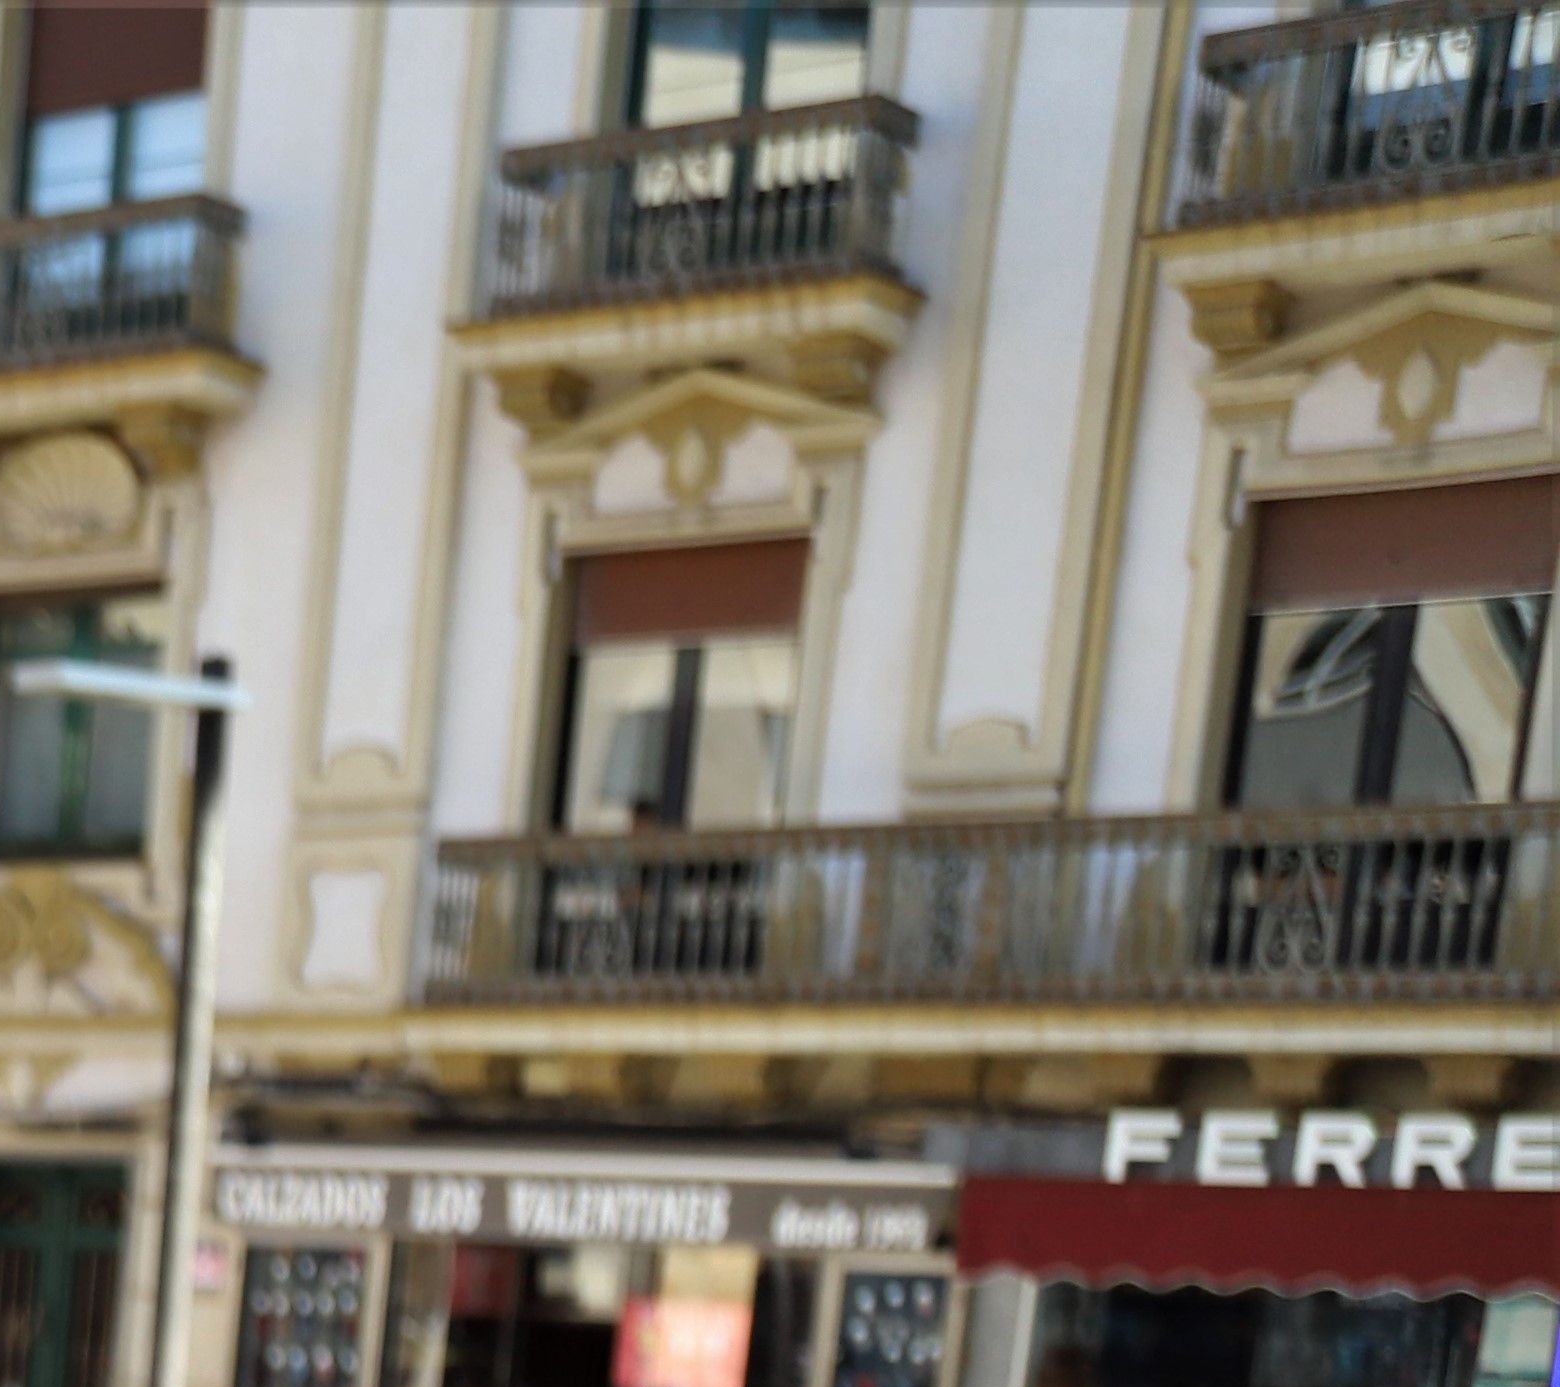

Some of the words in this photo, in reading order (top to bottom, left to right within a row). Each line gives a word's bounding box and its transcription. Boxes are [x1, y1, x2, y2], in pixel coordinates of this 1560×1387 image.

[1101, 1107, 1560, 1193] FERRE
[217, 1171, 389, 1229] CALZADOS
[410, 1176, 484, 1235] LOS
[507, 1180, 733, 1243] VALENTINES
